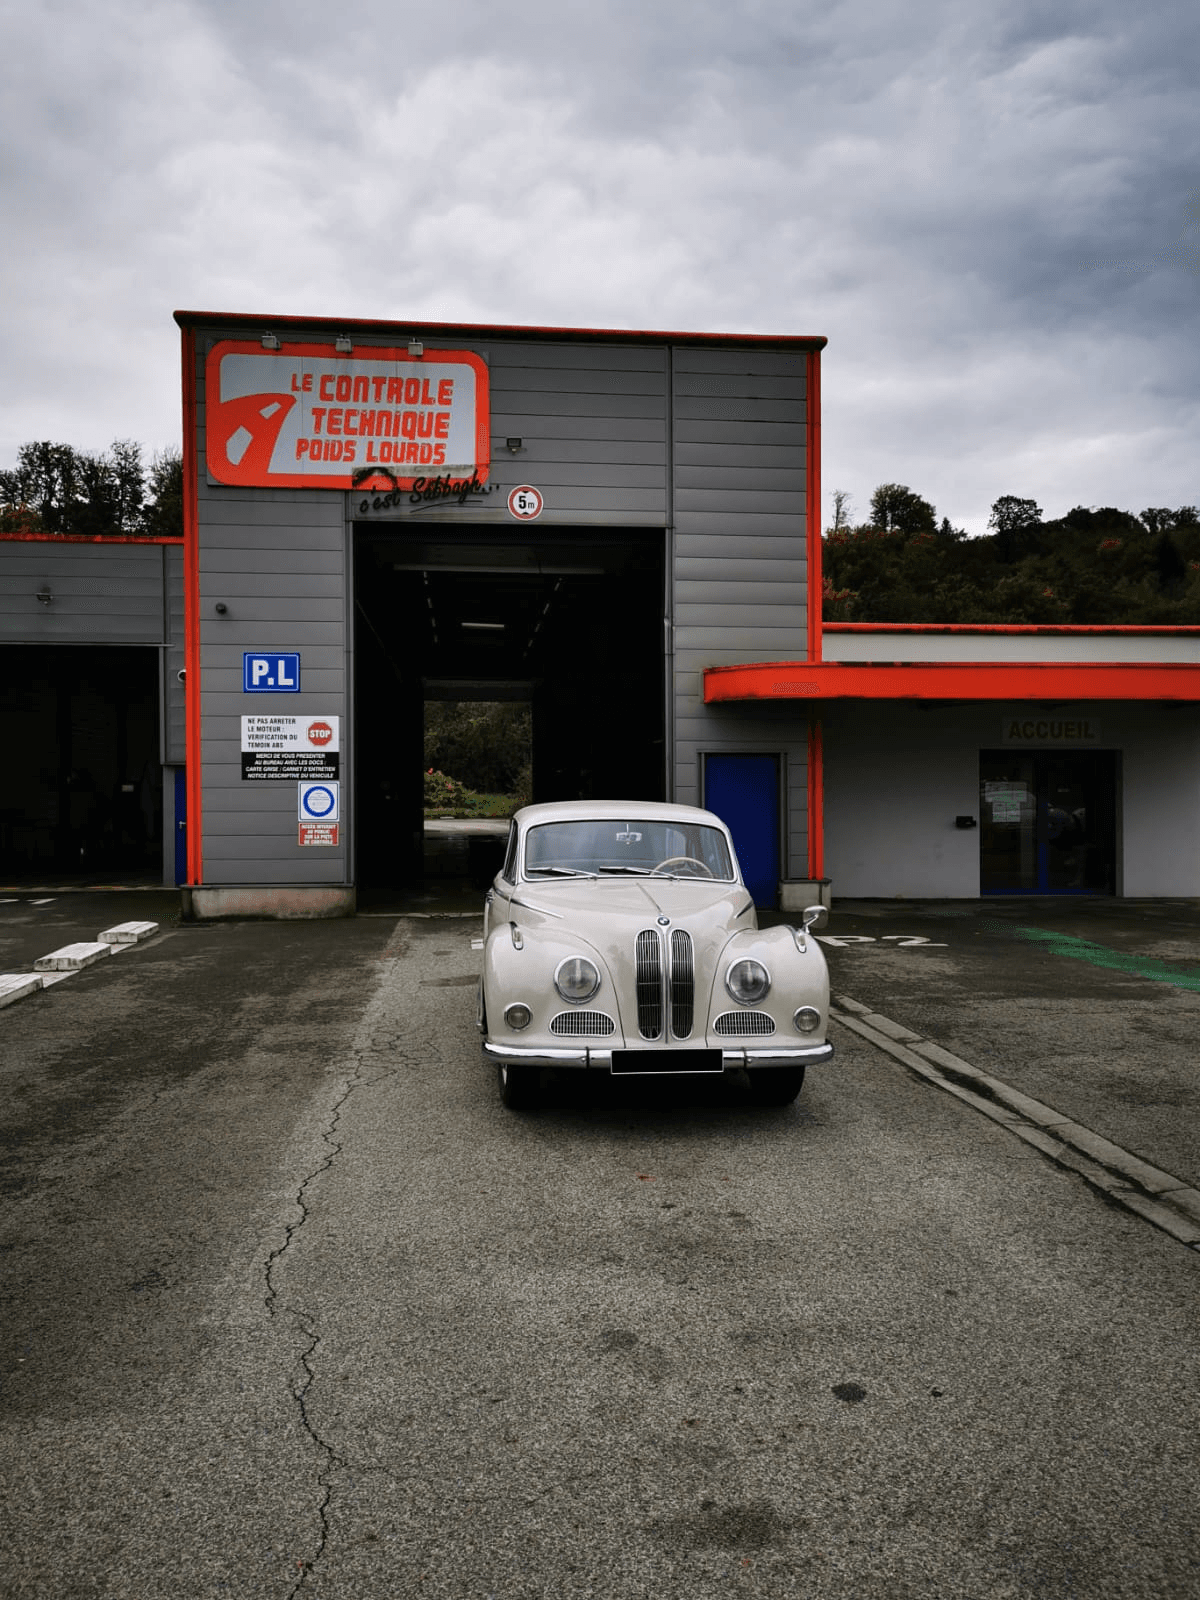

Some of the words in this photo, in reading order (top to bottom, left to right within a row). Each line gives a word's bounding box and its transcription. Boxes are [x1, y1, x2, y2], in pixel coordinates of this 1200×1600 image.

[291, 373, 313, 392] LE
[319, 374, 454, 406] CONTROLE
[312, 407, 451, 440] TECHNIQUE
[296, 438, 357, 462] POIDS
[366, 441, 447, 465] LOURDS
[252, 659, 294, 686] P.L
[309, 729, 331, 738] STOP
[1008, 720, 1095, 740] ACCUEIL
